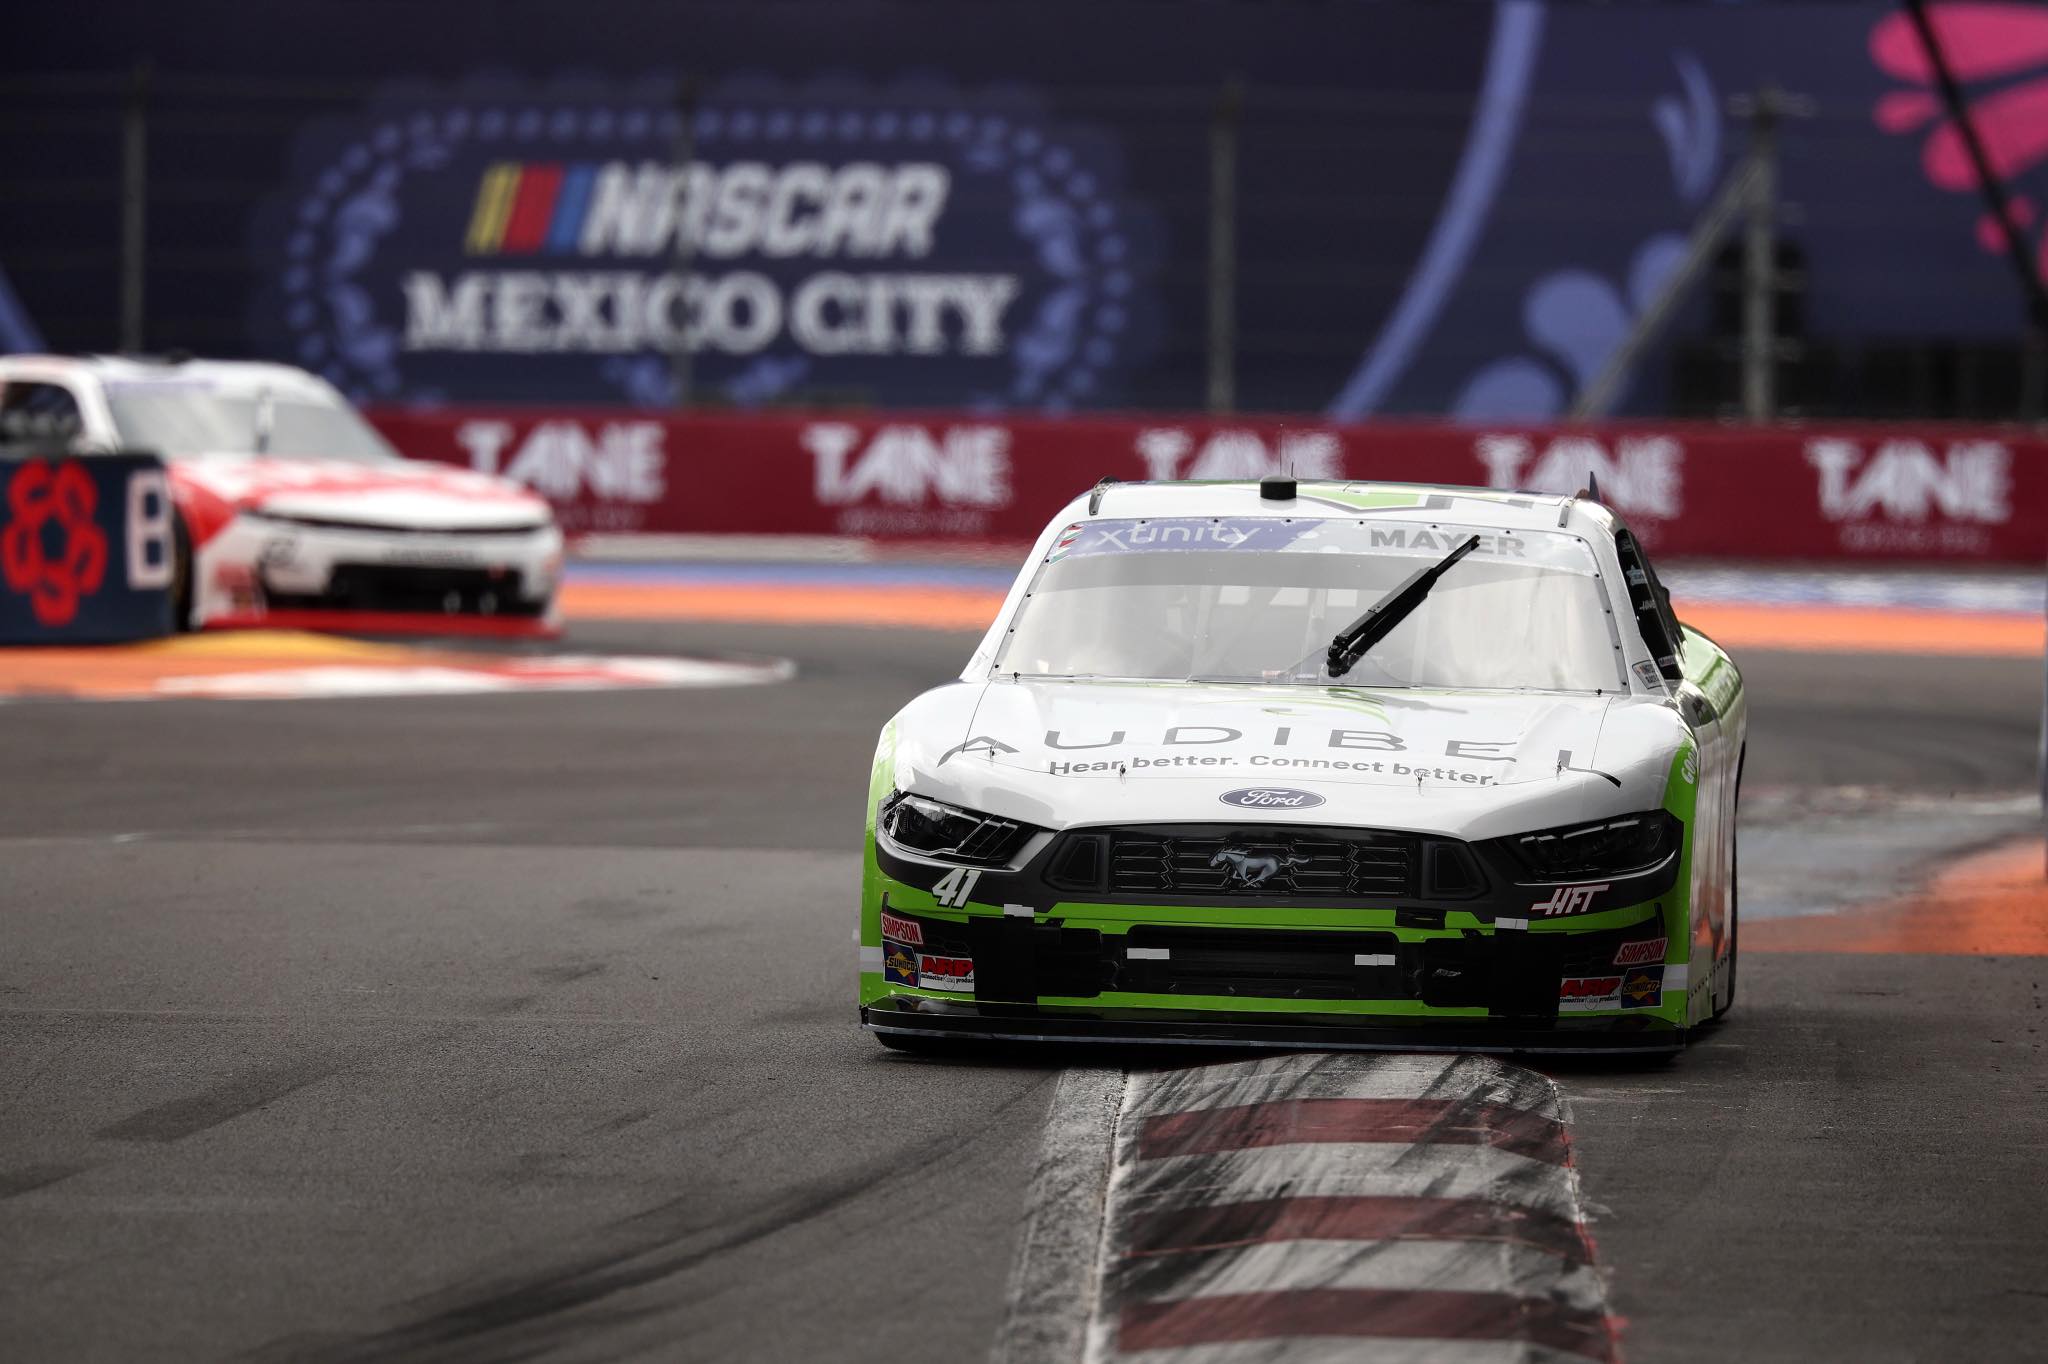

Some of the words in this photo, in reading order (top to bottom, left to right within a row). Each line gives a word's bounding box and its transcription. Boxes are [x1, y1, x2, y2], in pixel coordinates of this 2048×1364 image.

[579, 161, 950, 256] NASCAR
[402, 272, 782, 353] MEXICO
[793, 273, 1016, 354] CITY
[805, 423, 1011, 504] TANE
[1806, 438, 2013, 522] TANE
[1096, 524, 1264, 551] xfinity
[1369, 527, 1528, 558] MAYER
[936, 725, 1622, 789] AUDIBEL
[1049, 759, 1123, 776] Hear
[1131, 754, 1240, 769] better.
[1249, 753, 1385, 774] Connect
[1392, 762, 1499, 786] better.
[1240, 788, 1305, 807] Ford
[931, 867, 983, 909] 41
[1531, 883, 1611, 916] HFT
[883, 916, 920, 943] SIMPSON
[888, 957, 917, 972] SUNOCO
[921, 956, 974, 977] ARP
[1617, 940, 1666, 963] SIMPSON
[1623, 980, 1660, 994] SUNOCO
